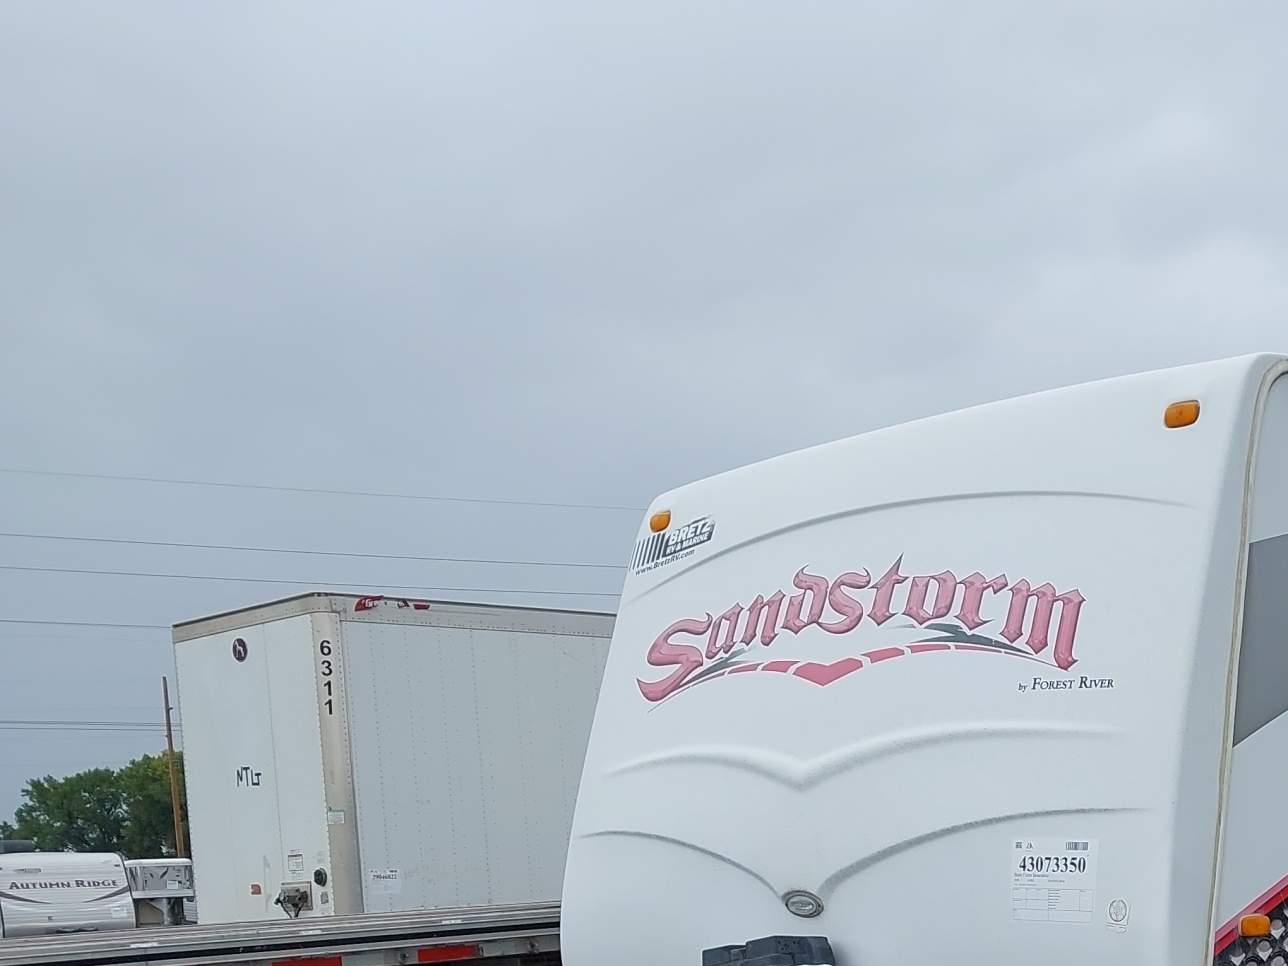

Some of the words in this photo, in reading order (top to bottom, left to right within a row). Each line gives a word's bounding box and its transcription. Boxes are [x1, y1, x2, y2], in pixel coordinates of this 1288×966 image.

[668, 520, 711, 545] BRETZ
[637, 553, 1087, 702] Sandstorm
[319, 639, 334, 716] 6311
[1018, 683, 1028, 693] by
[1031, 677, 1075, 690] FOREST
[1078, 676, 1114, 689] RIVER
[1019, 856, 1086, 873] 43073350
[9, 881, 71, 890] AUTUMN
[74, 879, 119, 888] RIDGE
